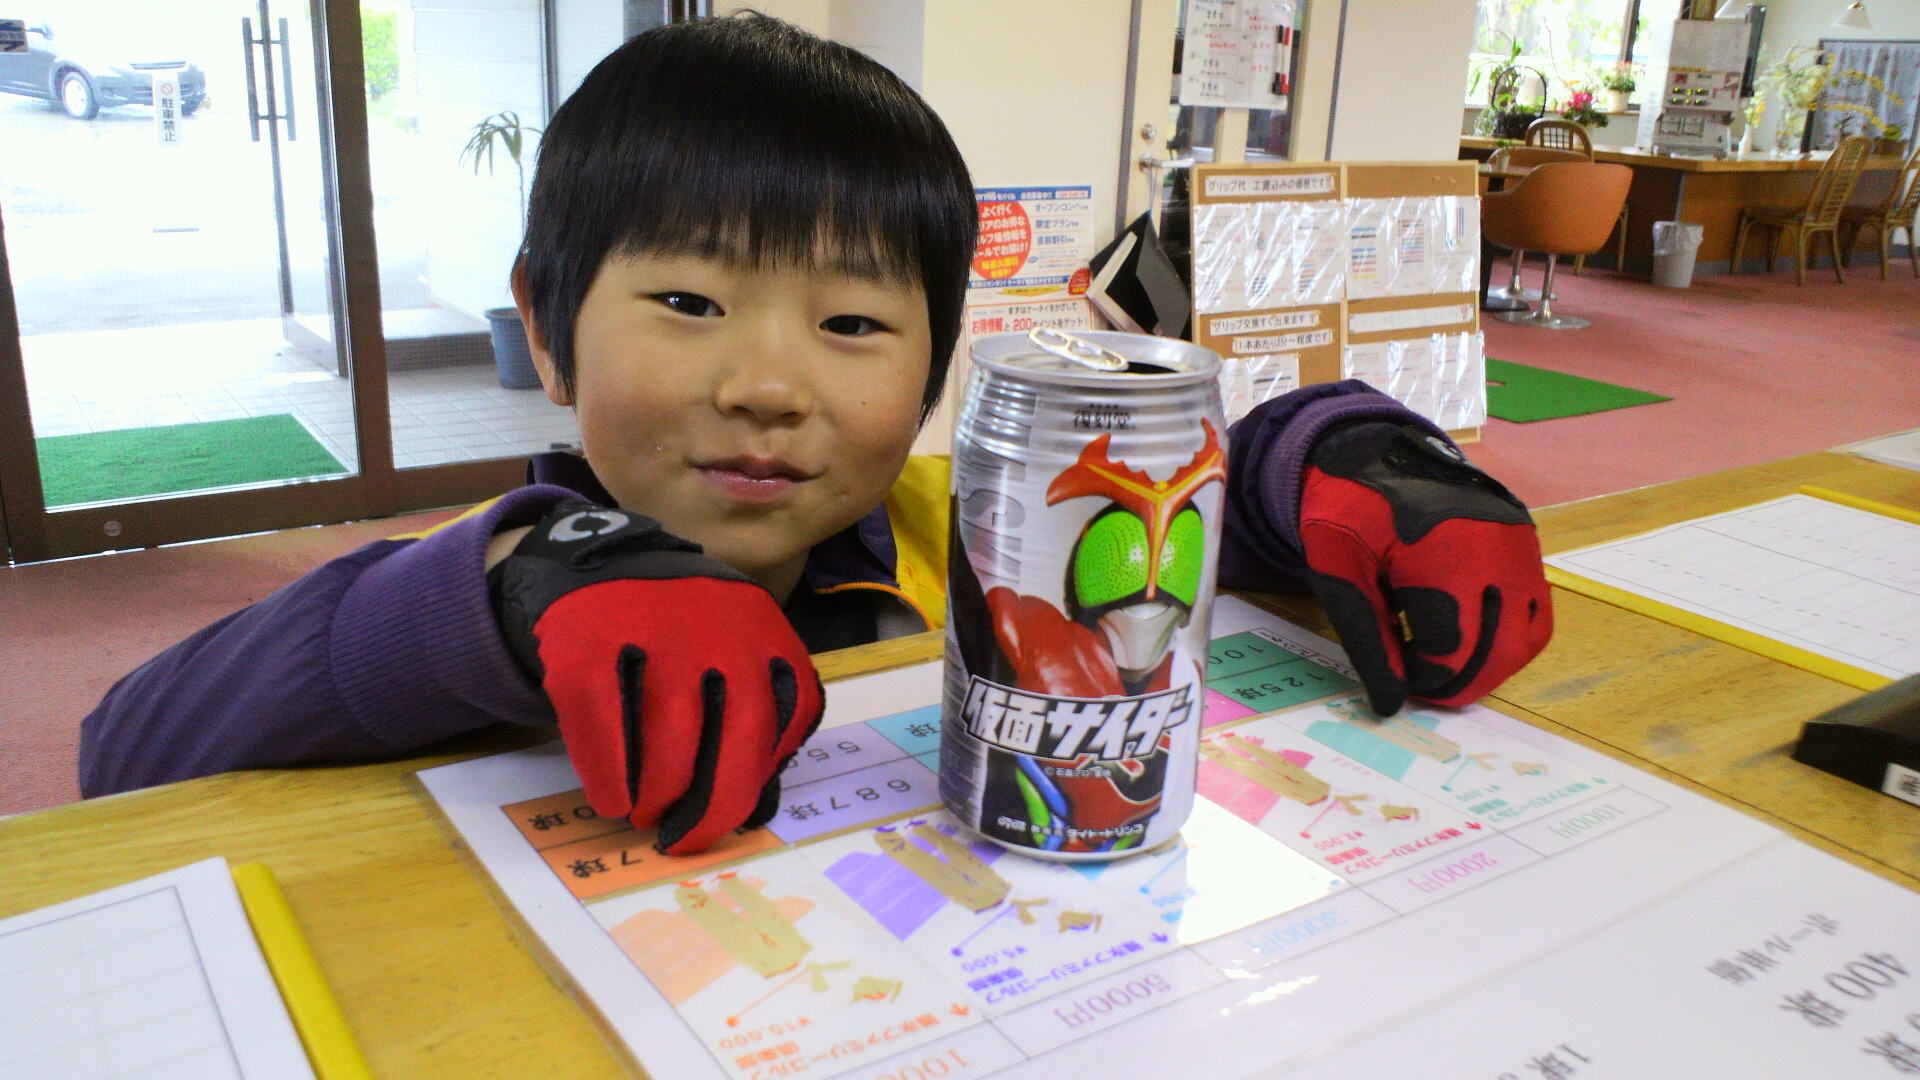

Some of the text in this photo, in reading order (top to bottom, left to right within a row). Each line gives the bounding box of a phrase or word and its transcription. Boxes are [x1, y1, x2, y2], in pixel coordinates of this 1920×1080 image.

[162, 97, 176, 142] 駐車禁止
[1209, 180, 1246, 192] グリップ代
[978, 216, 1026, 231] リアのお得な
[981, 203, 1013, 218] よく行く
[977, 229, 1027, 245] ルフ場情報を
[905, 722, 941, 738] 球
[964, 680, 1193, 759] 仮面サイダー
[784, 779, 911, 822] 687球
[1547, 803, 1626, 840] 1000円
[1313, 830, 1367, 851] ¥2,000
[1407, 851, 1499, 894] 2000円
[1244, 908, 1349, 957] 3000円
[961, 945, 1029, 973] ¥5,000
[1053, 973, 1172, 1029] 5000円
[719, 1017, 812, 1050] ¥10,000
[874, 1047, 969, 1080] 100
